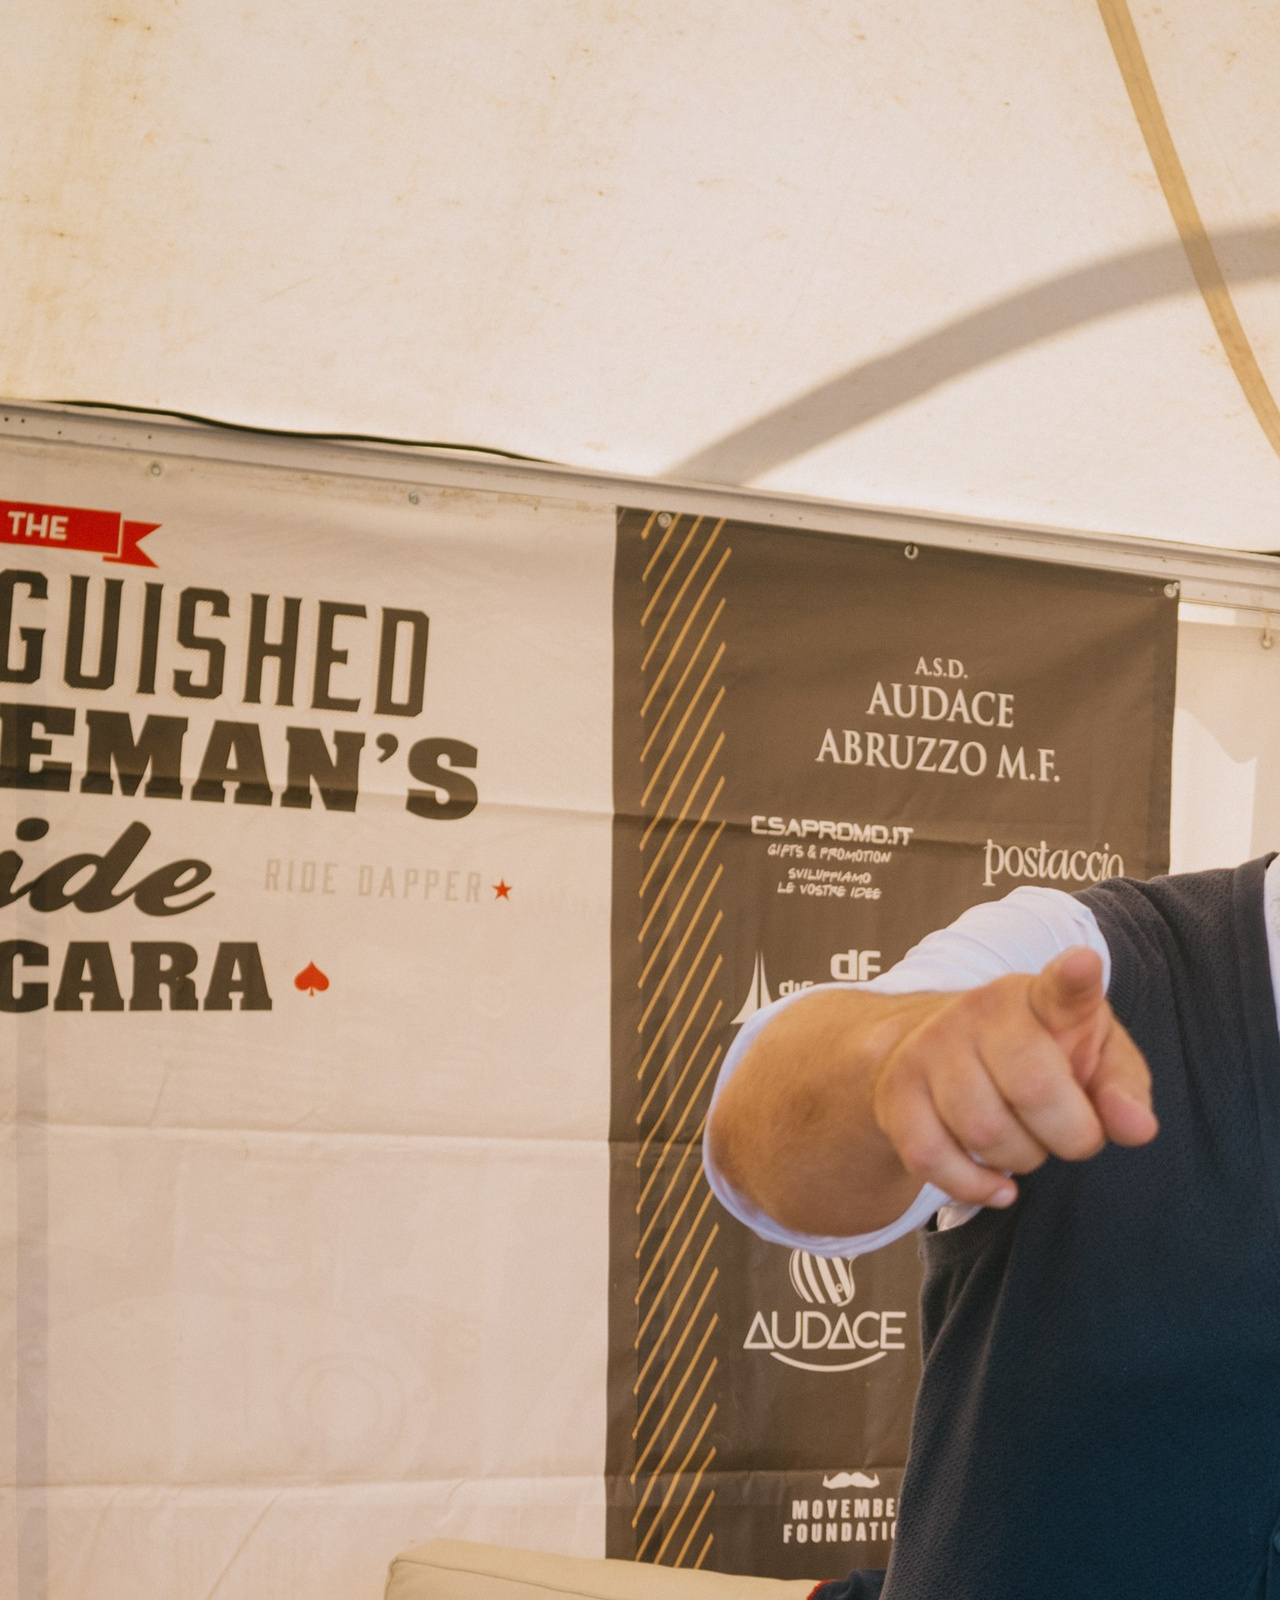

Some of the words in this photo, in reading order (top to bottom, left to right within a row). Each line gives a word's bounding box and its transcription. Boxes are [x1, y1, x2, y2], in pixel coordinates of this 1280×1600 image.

[8, 510, 68, 541] THE
[0, 568, 430, 718] GUISHED
[914, 656, 968, 680] A.S.D.
[866, 681, 1015, 729] AUDACE
[815, 728, 987, 777] ABRUZZO
[996, 745, 1061, 783] M.F.
[751, 815, 914, 846] CSAPROMO.IT
[767, 843, 804, 859] GIFTS
[807, 844, 817, 859] &
[819, 847, 892, 863] PROMOTION
[982, 838, 1125, 887] postaccio
[264, 858, 339, 895] RIDE
[358, 864, 482, 902] DAPPER
[777, 881, 796, 894] LE
[799, 883, 846, 898] VOSTRE
[850, 886, 882, 900] IDEE
[788, 867, 872, 885] SVILUPPIAMO
[0, 939, 272, 1013] CARA
[743, 1310, 907, 1350] AUDACE
[792, 1498, 899, 1520] MOVEMBE
